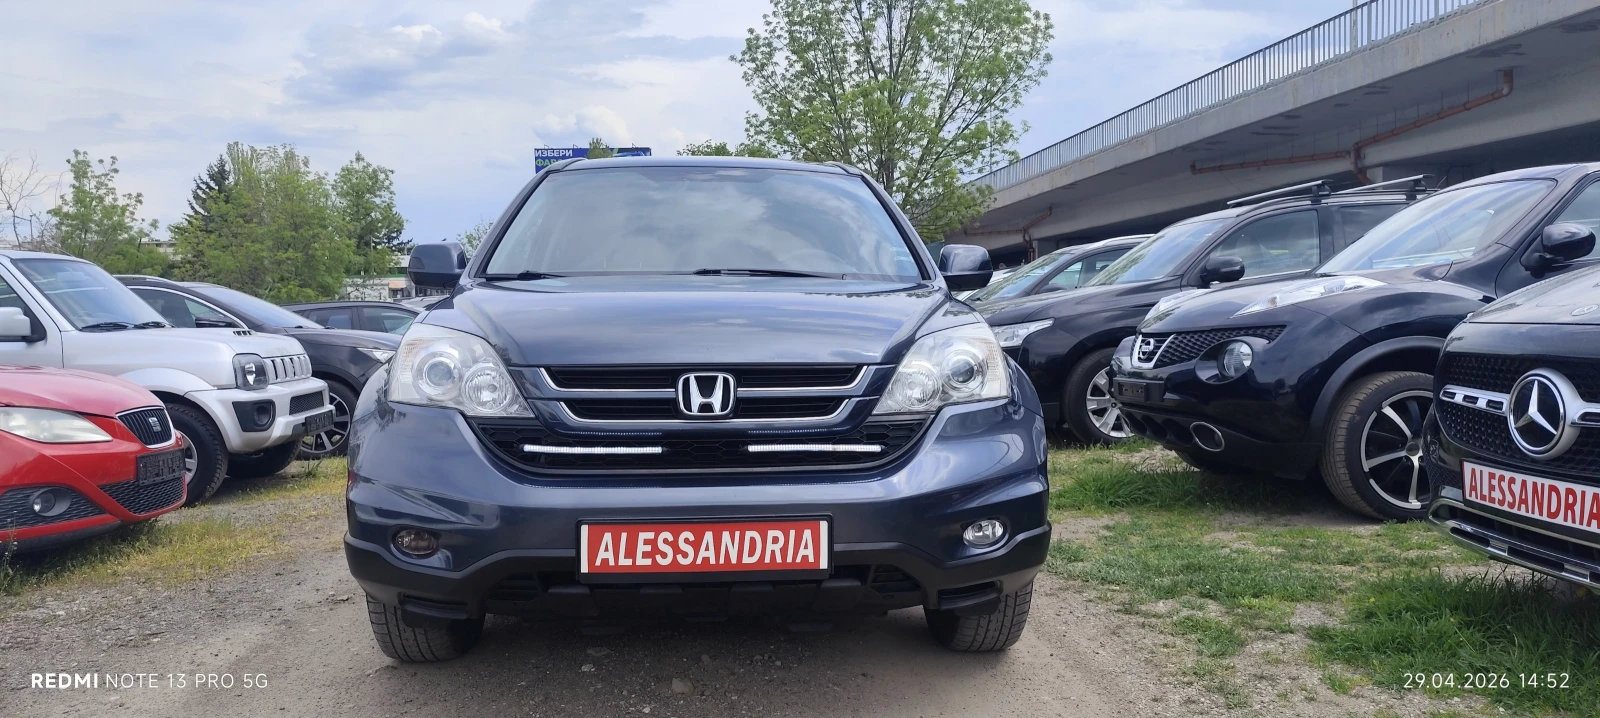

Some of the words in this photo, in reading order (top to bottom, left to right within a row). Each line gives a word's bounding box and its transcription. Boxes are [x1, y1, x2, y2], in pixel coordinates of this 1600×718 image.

[535, 149, 573, 157] ИЗБЕРИ
[1468, 467, 1600, 530] ALESSANDRIA
[594, 528, 816, 567] ALESSANDRIA
